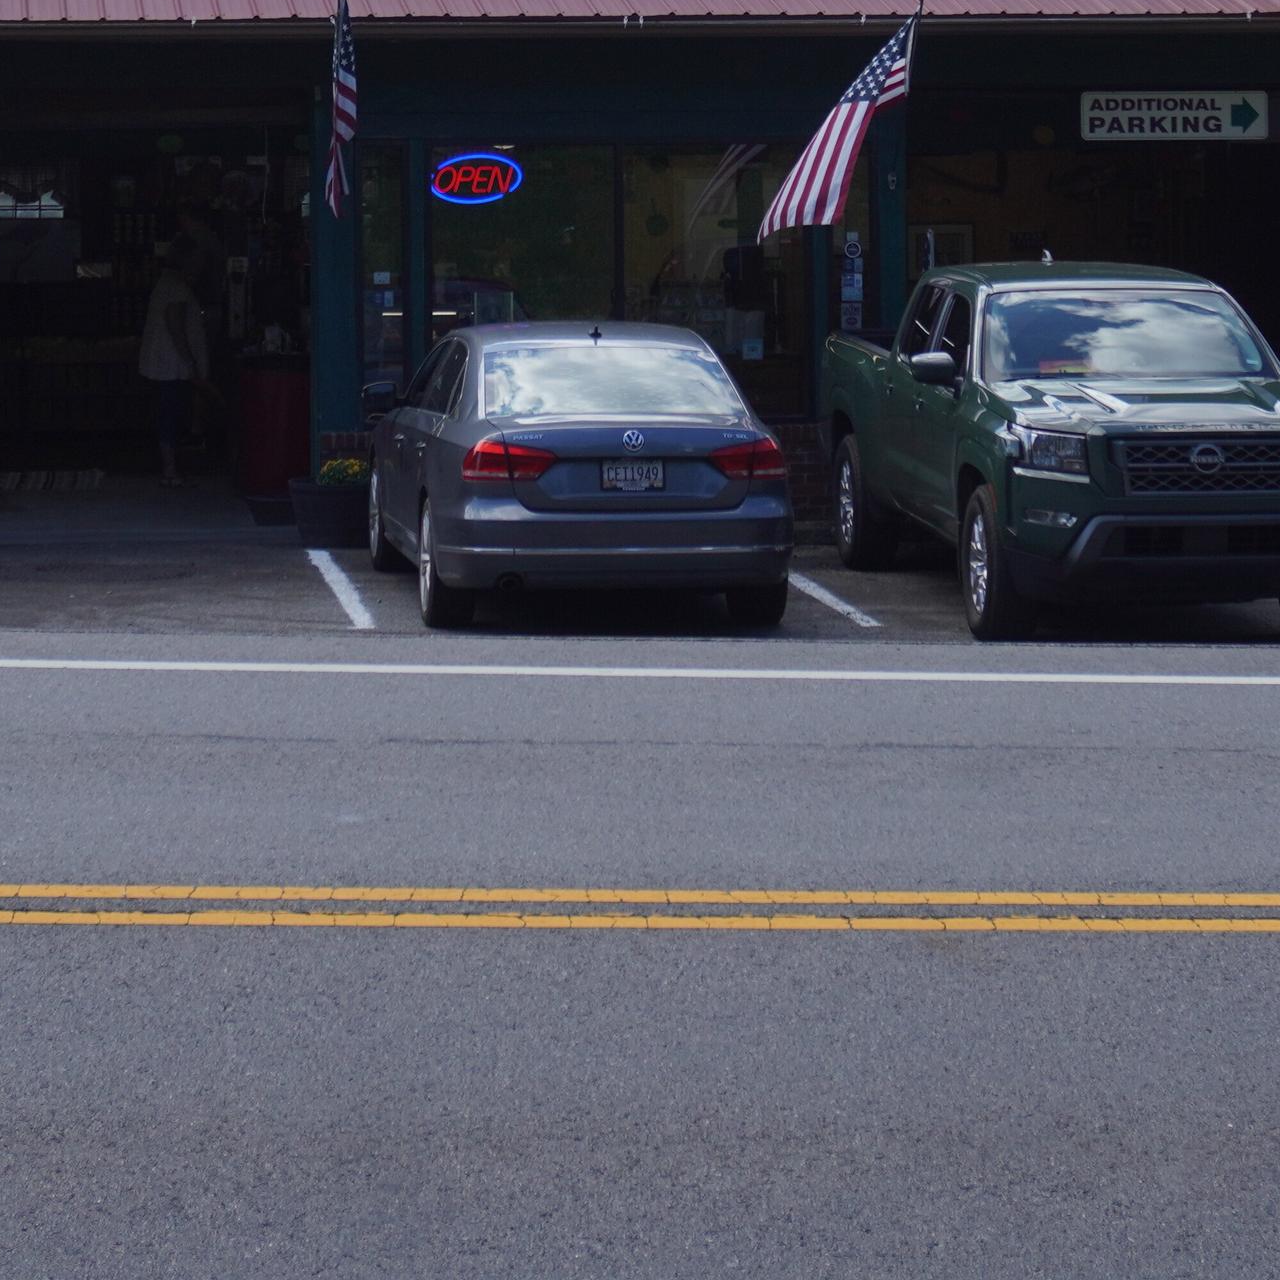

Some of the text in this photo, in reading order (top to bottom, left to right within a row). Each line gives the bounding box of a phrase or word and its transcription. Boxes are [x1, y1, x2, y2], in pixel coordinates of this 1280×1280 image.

[1089, 98, 1223, 112] ADDITIONAL
[1088, 115, 1223, 134] PARKING
[433, 165, 514, 194] OPEN
